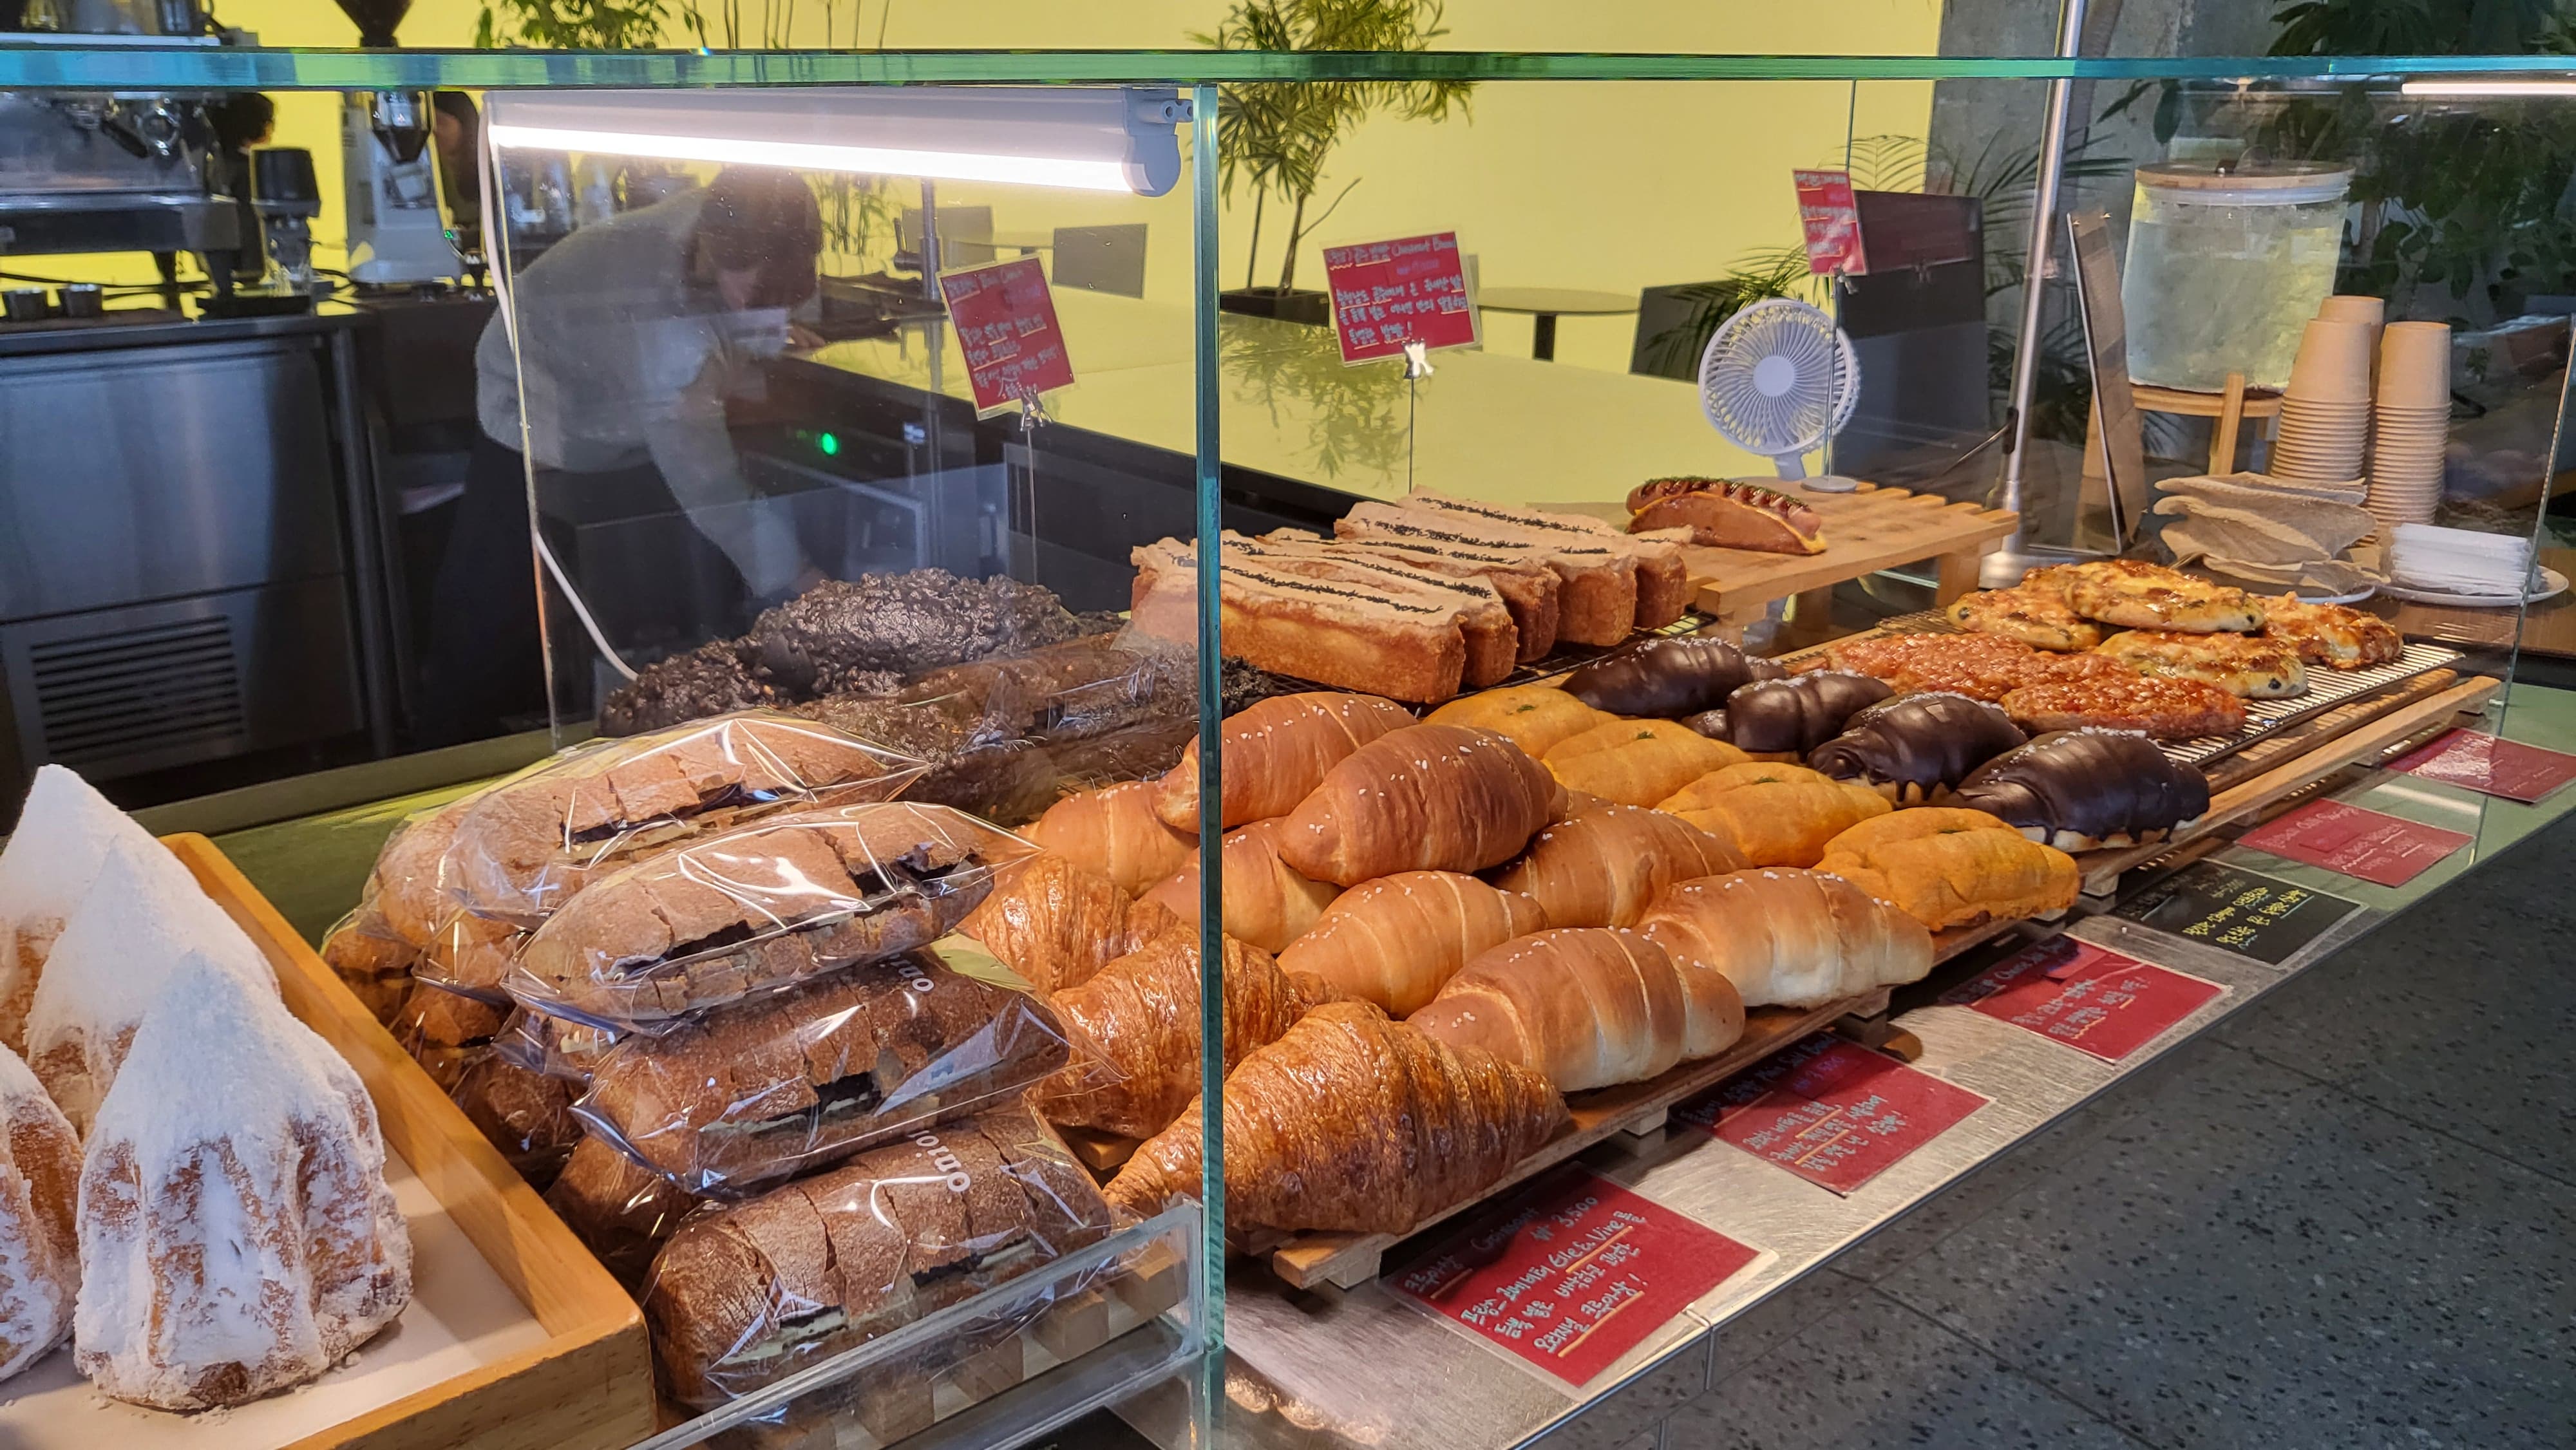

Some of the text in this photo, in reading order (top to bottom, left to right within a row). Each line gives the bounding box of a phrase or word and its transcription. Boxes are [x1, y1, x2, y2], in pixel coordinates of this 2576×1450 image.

[880, 953, 934, 992] oni
[1460, 1299, 1507, 1326] 프랑스
[1494, 1317, 1534, 1339] 듬뿍
[1522, 1301, 1554, 1318] 넣은
[1533, 1317, 1591, 1353] 오리지널
